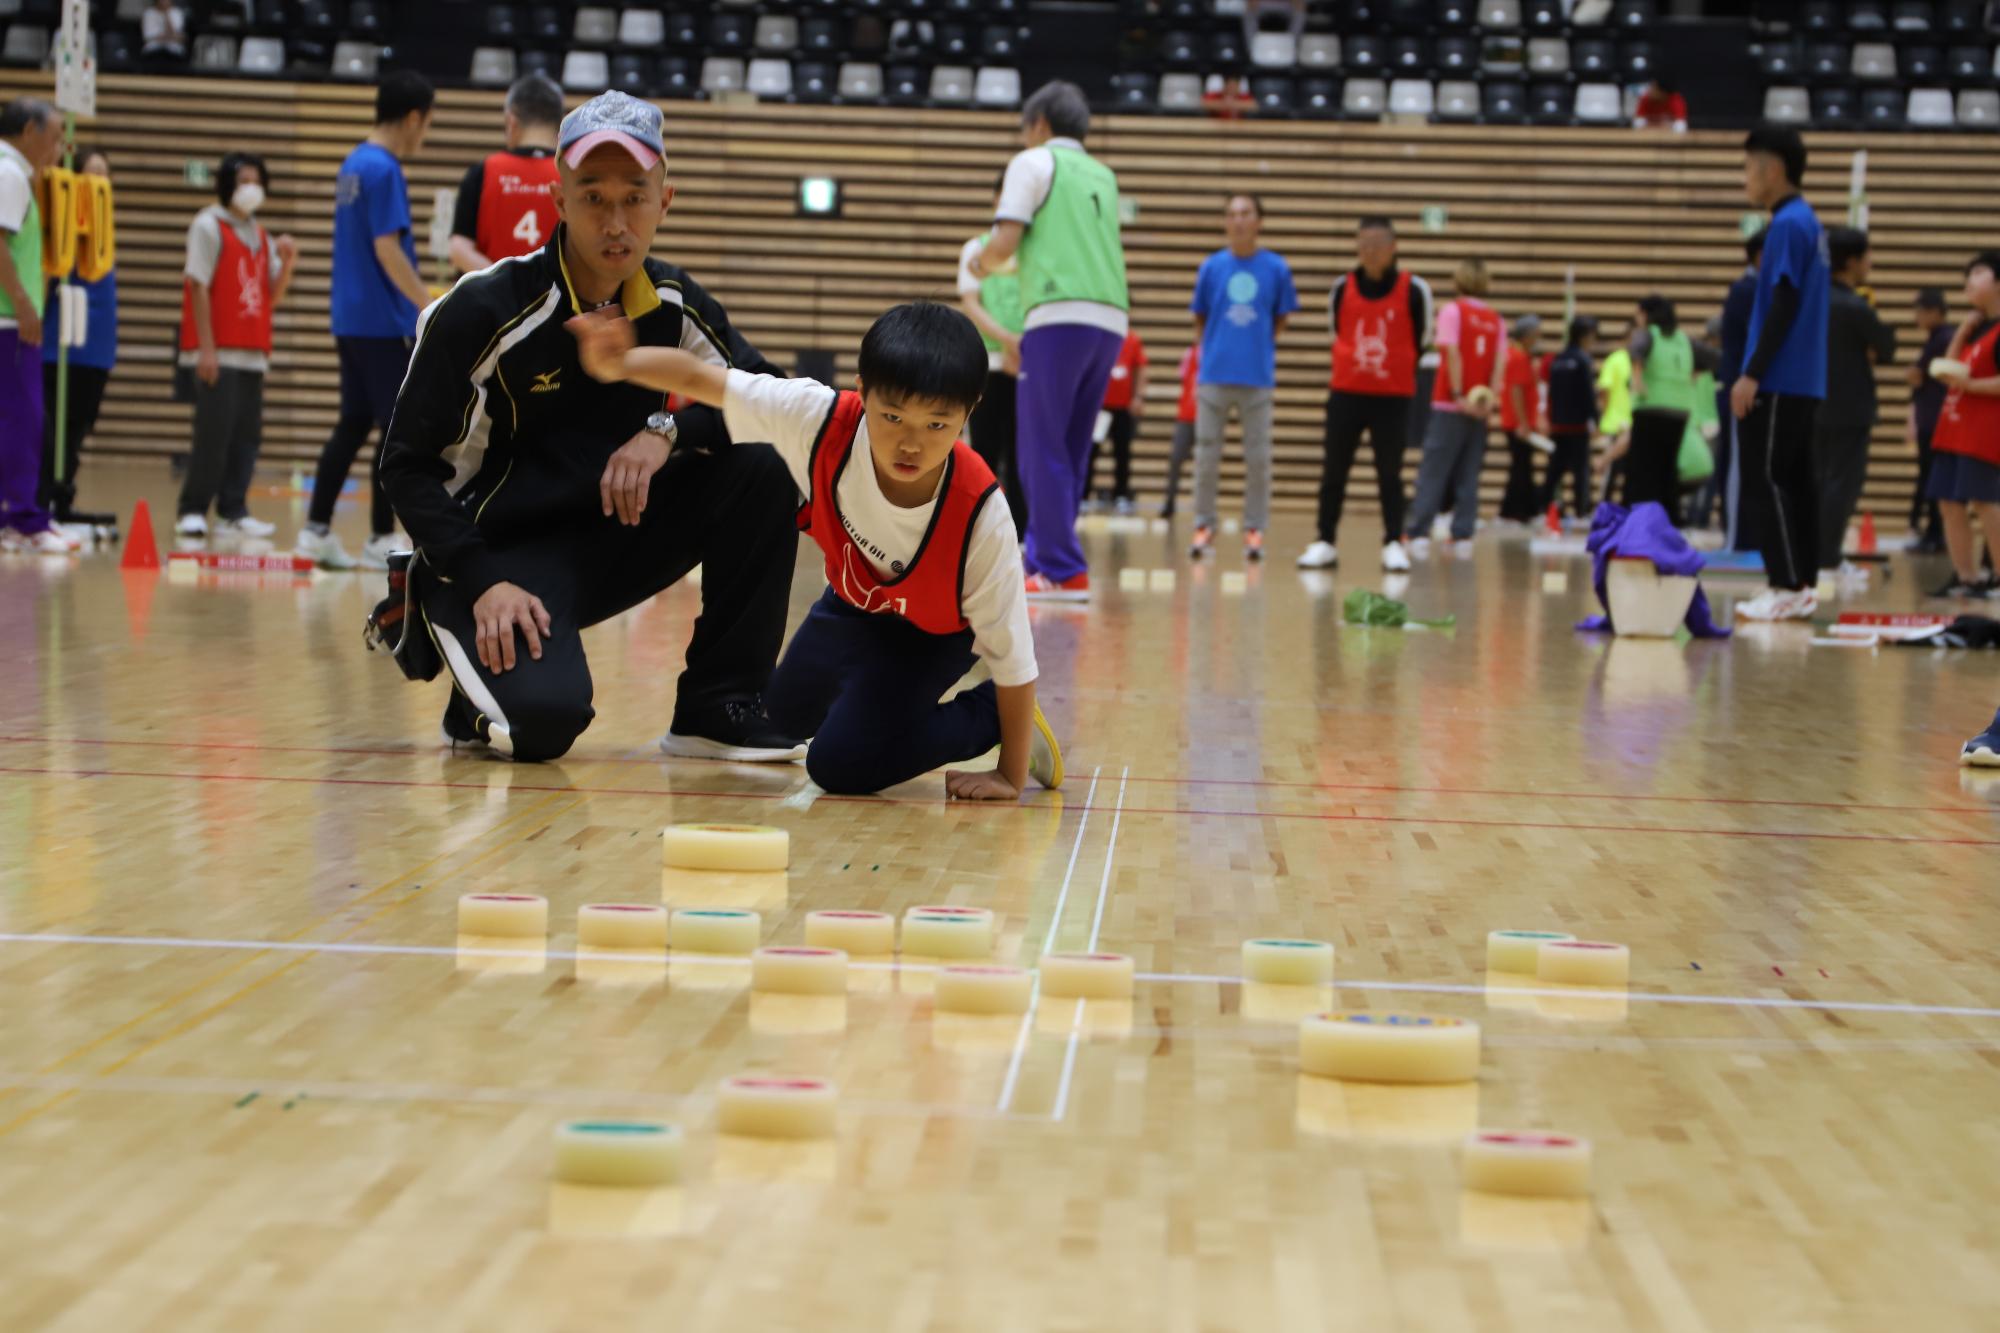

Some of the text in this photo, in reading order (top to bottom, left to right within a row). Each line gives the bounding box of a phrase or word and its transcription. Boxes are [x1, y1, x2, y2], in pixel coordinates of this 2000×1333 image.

[1090, 192, 1102, 218] 1
[513, 209, 541, 246] 4
[869, 544, 886, 561] OIL
